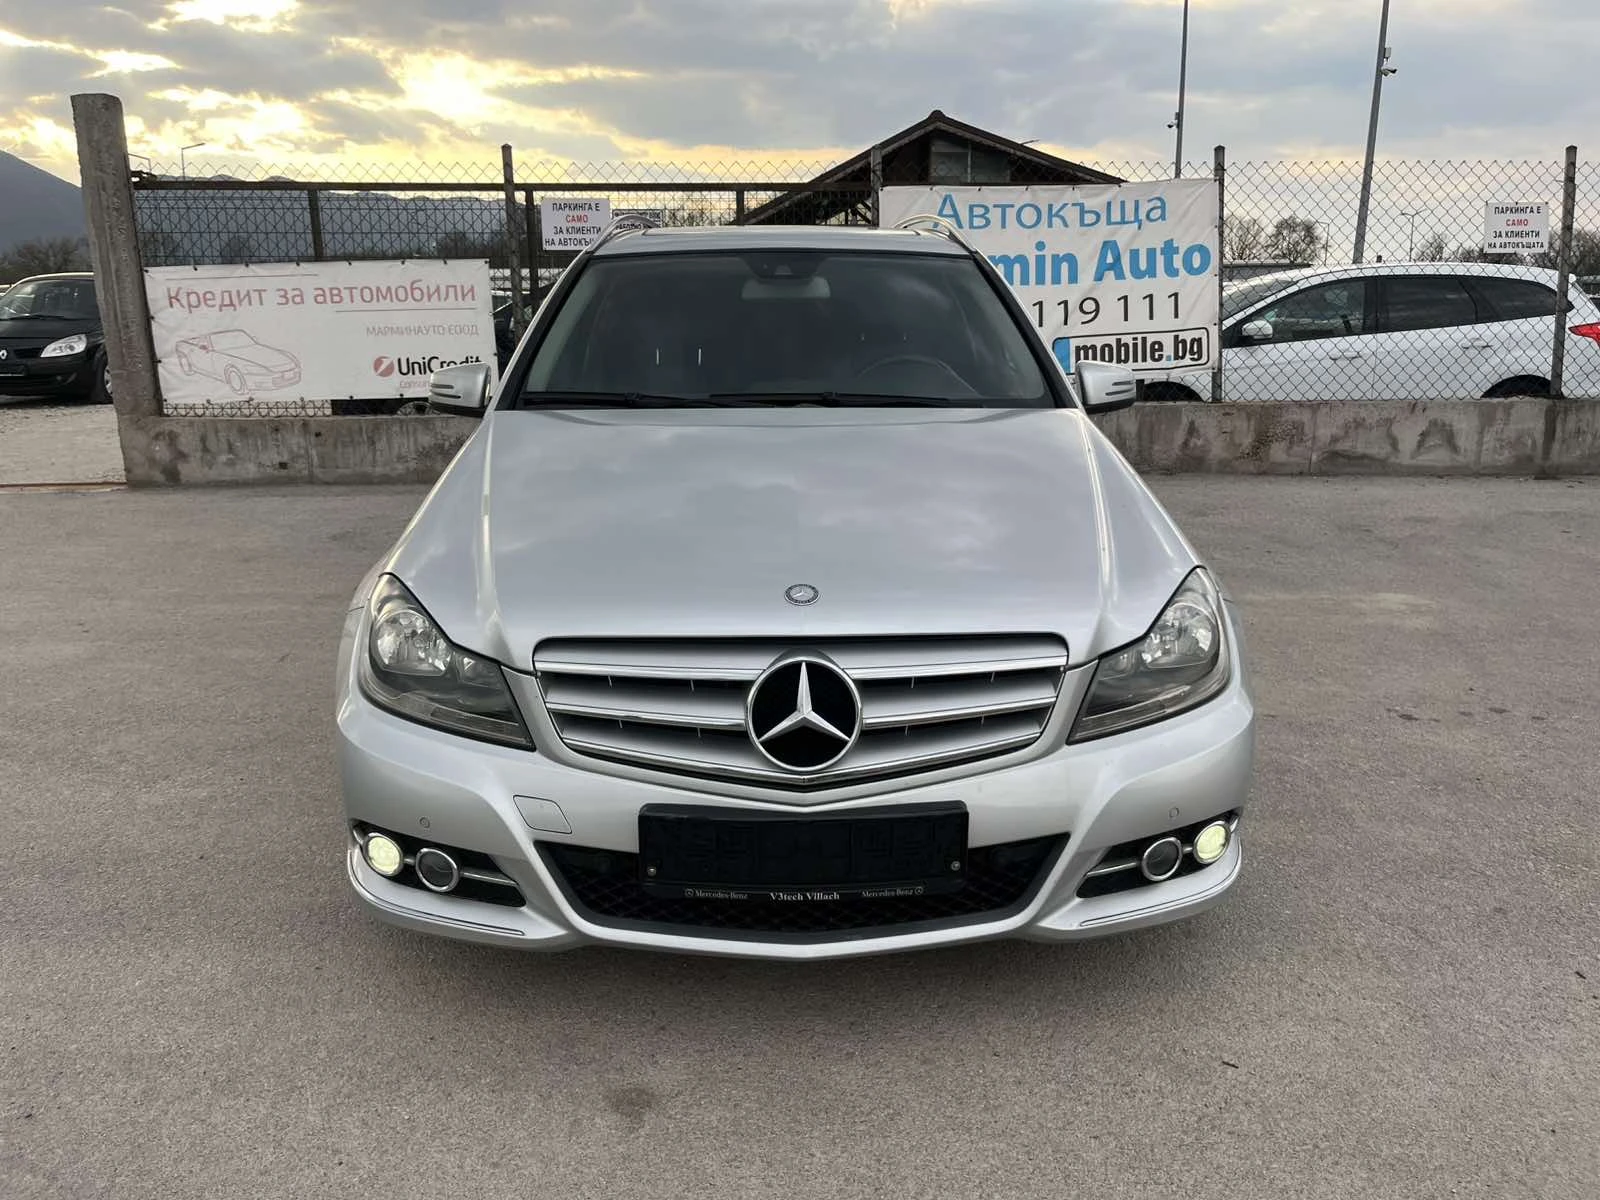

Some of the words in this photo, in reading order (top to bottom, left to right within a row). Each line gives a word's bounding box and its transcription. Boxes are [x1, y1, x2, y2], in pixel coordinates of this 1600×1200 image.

[552, 203, 593, 212] ПАРКИНГА
[594, 203, 600, 211] Е
[1494, 206, 1535, 215] ПАРКИНГА
[1537, 206, 1541, 214] Е
[932, 194, 1167, 231] Автокъща
[566, 215, 588, 223] САМО
[1506, 219, 1529, 227] САМО
[554, 226, 565, 235] ЗА
[566, 226, 601, 235] КЛИЕНТИ
[1493, 231, 1503, 239] ЗА
[1505, 231, 1540, 239] КЛИЕНТИ
[558, 238, 594, 247] АВТОКЪ
[1499, 241, 1544, 249] АВТОКЪЩАТА
[1093, 238, 1212, 282] Auto
[167, 286, 268, 313] Кредит
[276, 287, 305, 305] за
[313, 279, 477, 305] автомобили
[1032, 296, 1101, 327] 119
[1116, 291, 1180, 322] 111
[1074, 334, 1203, 365] mobile.bg
[806, 891, 840, 901] Villach
